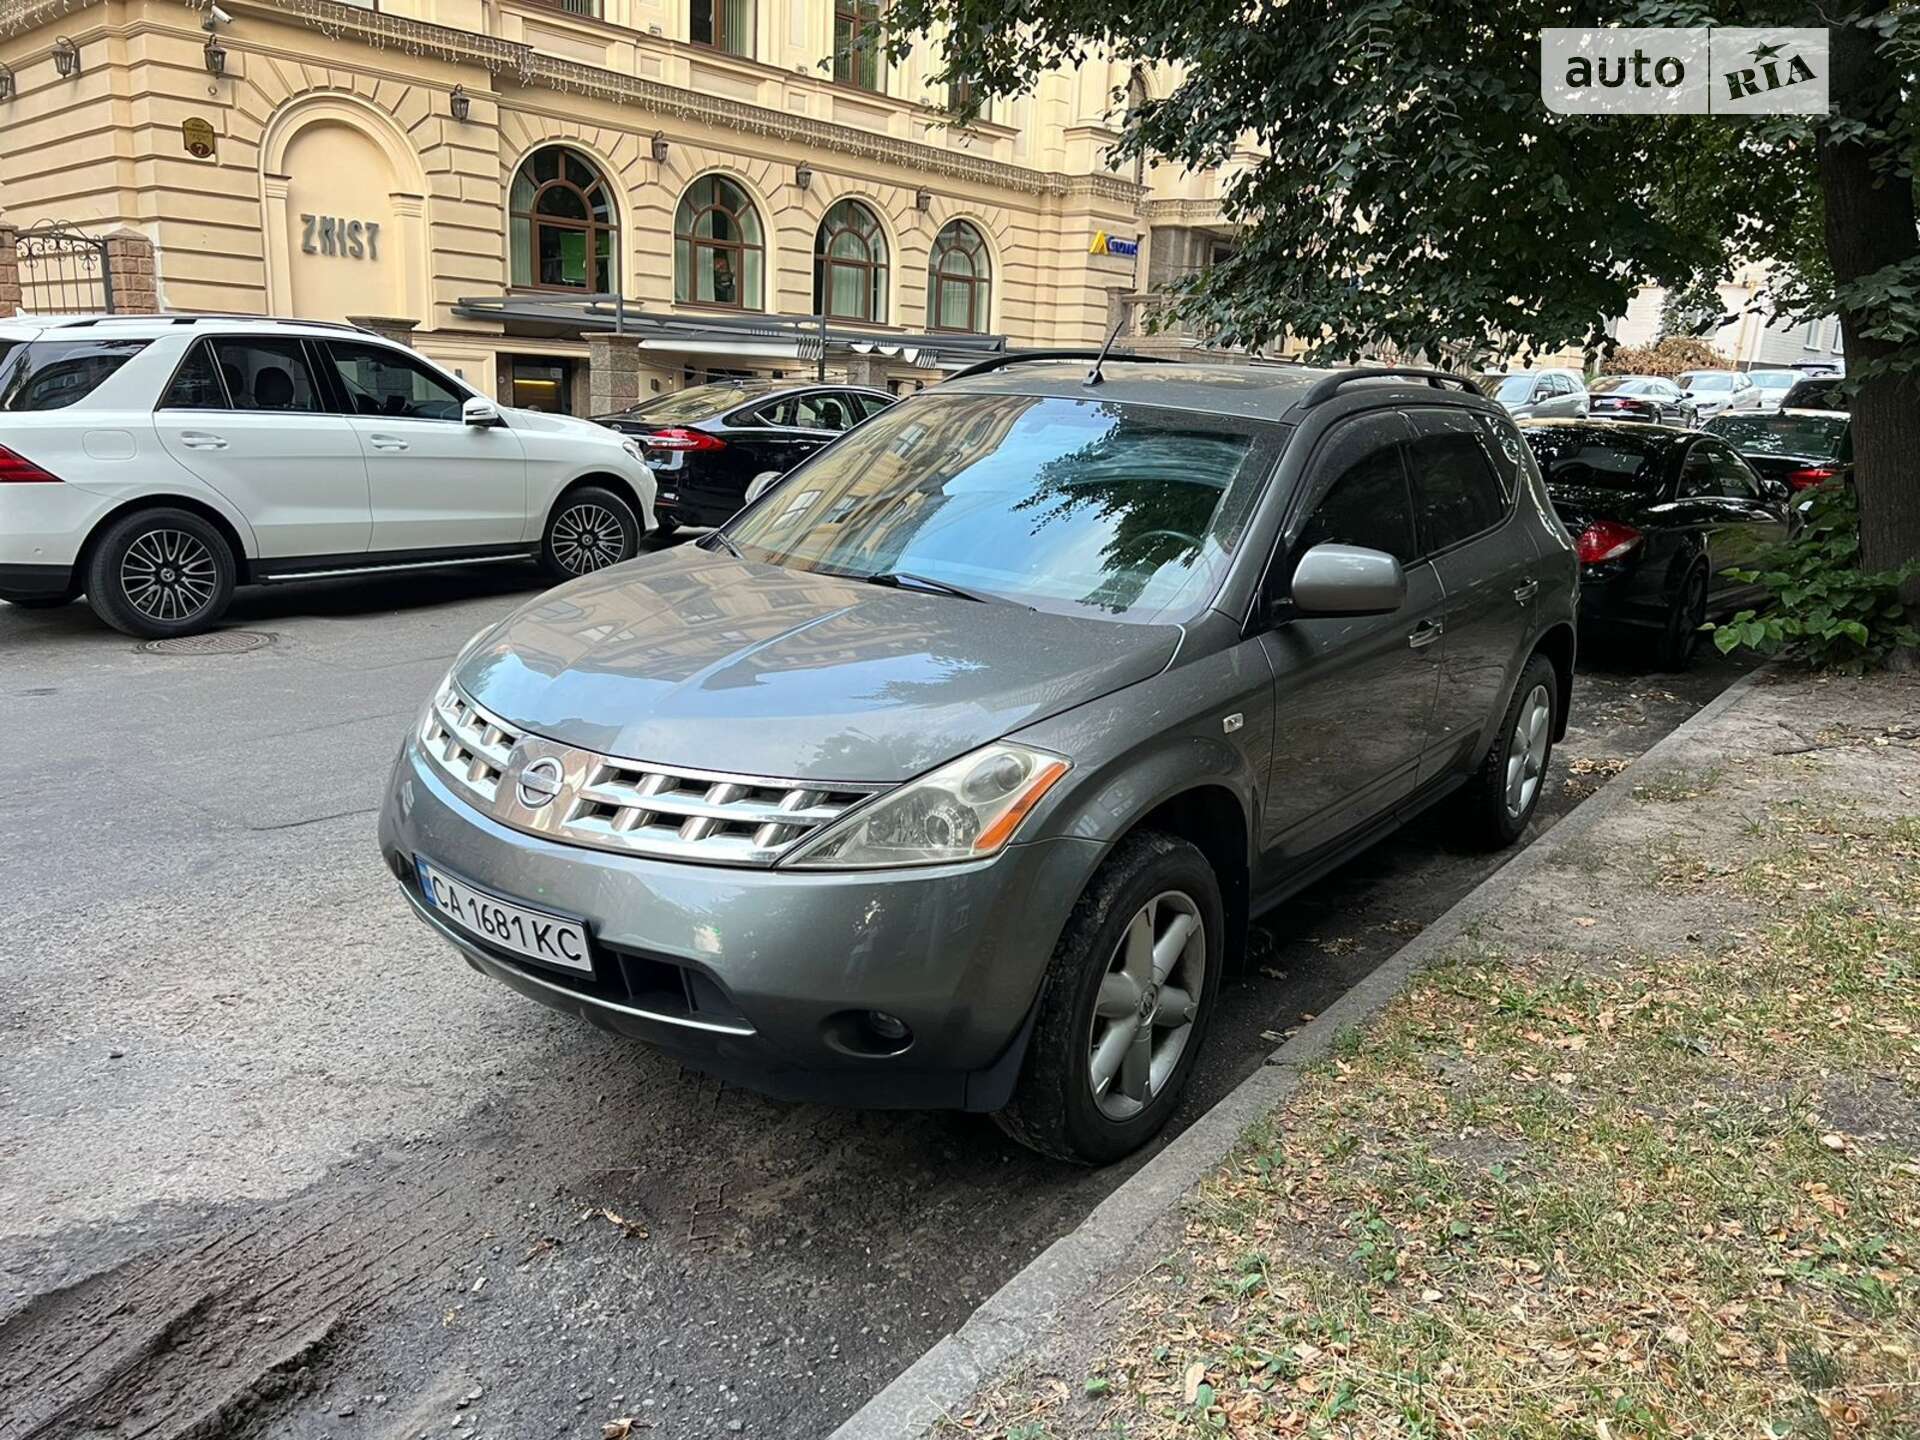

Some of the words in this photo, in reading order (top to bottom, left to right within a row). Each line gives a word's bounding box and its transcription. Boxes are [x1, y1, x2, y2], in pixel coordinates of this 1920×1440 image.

[432, 876, 466, 921] CA
[468, 897, 528, 948] 1681
[532, 920, 582, 961] KC
